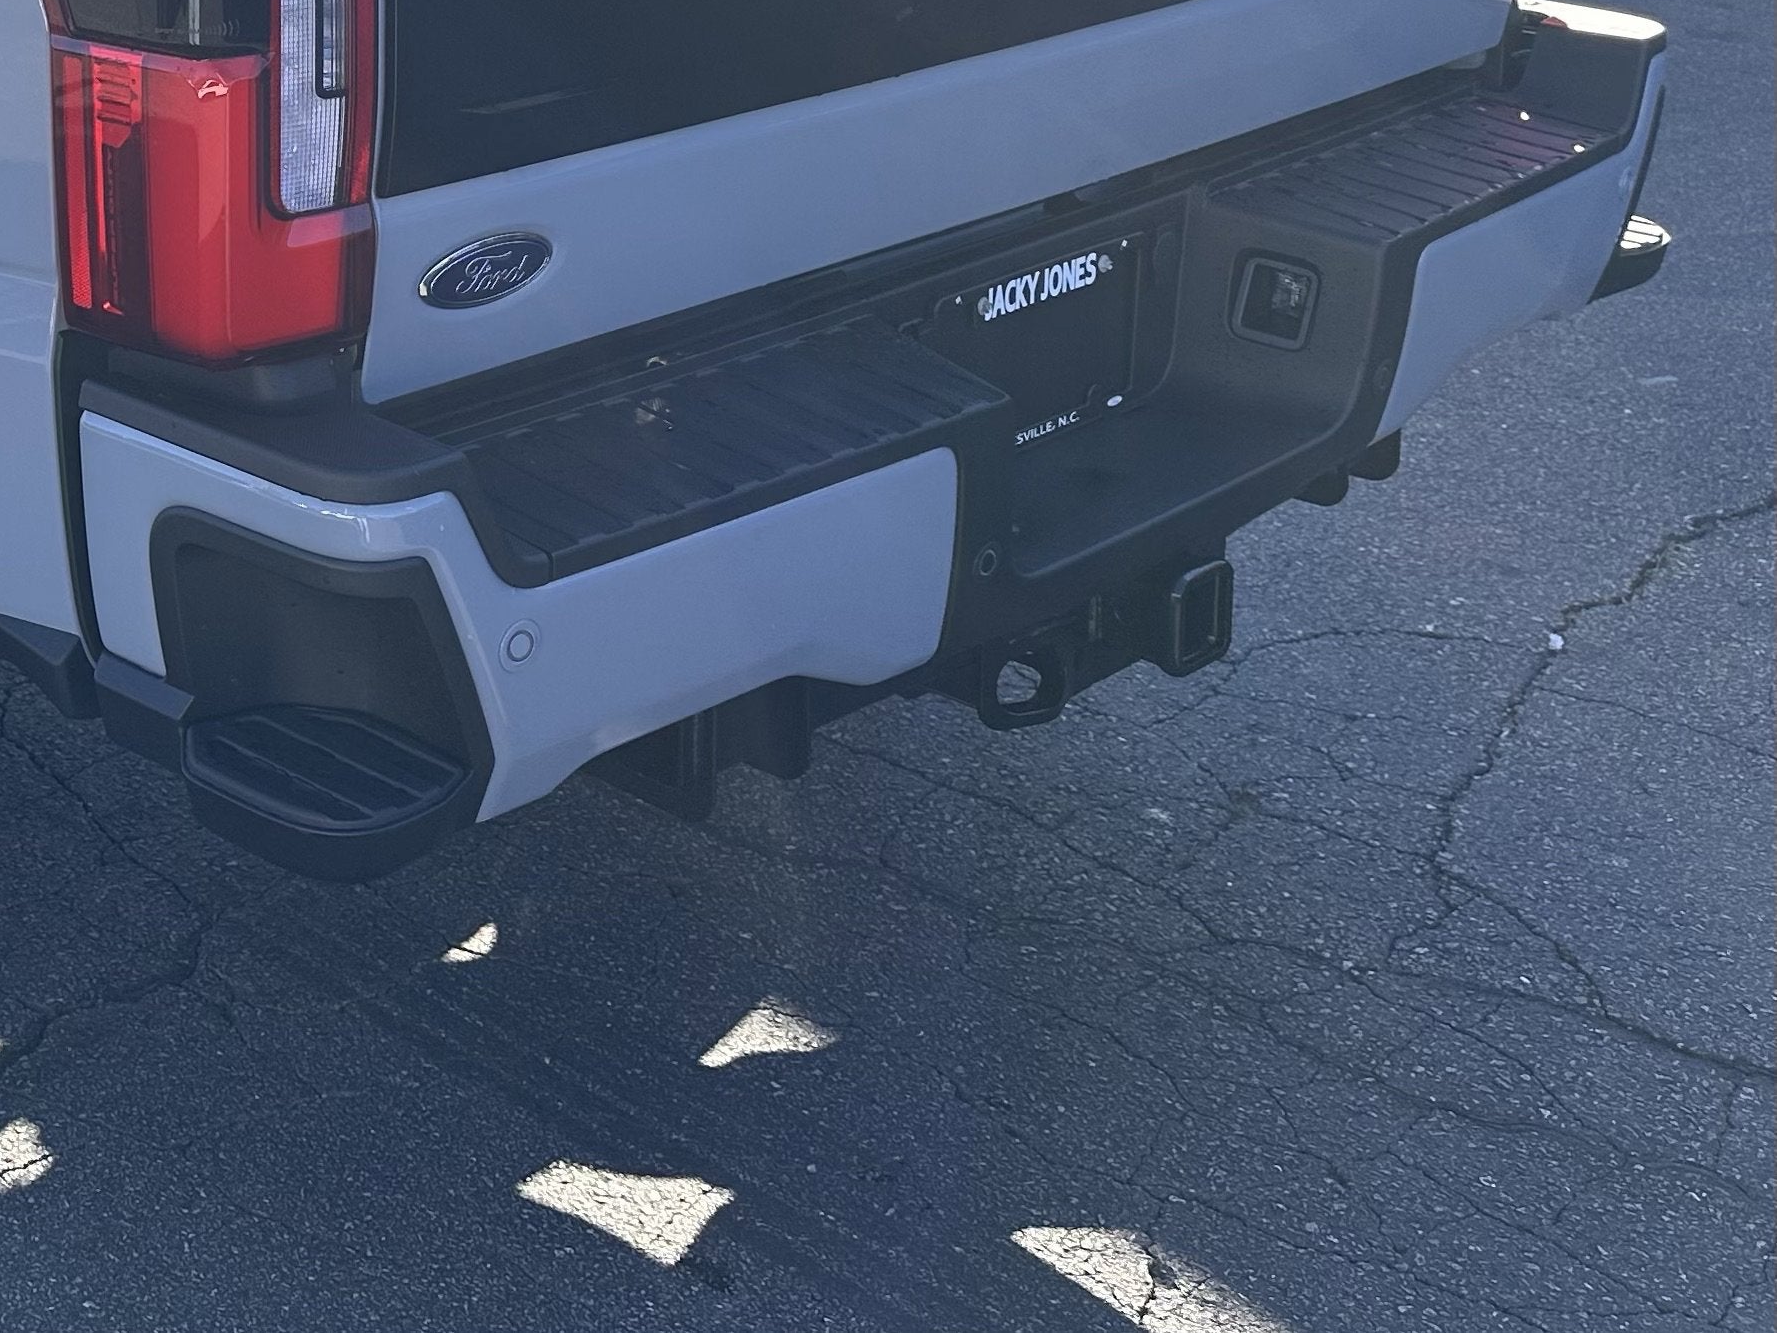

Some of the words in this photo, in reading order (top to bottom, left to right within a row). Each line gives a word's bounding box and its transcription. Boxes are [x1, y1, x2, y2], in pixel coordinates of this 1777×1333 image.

[455, 250, 529, 294] Ford
[984, 271, 1041, 322] JACKY
[1040, 252, 1097, 301] JONES
[1014, 420, 1056, 445] SVILLE,
[1057, 411, 1079, 428] N.C.
